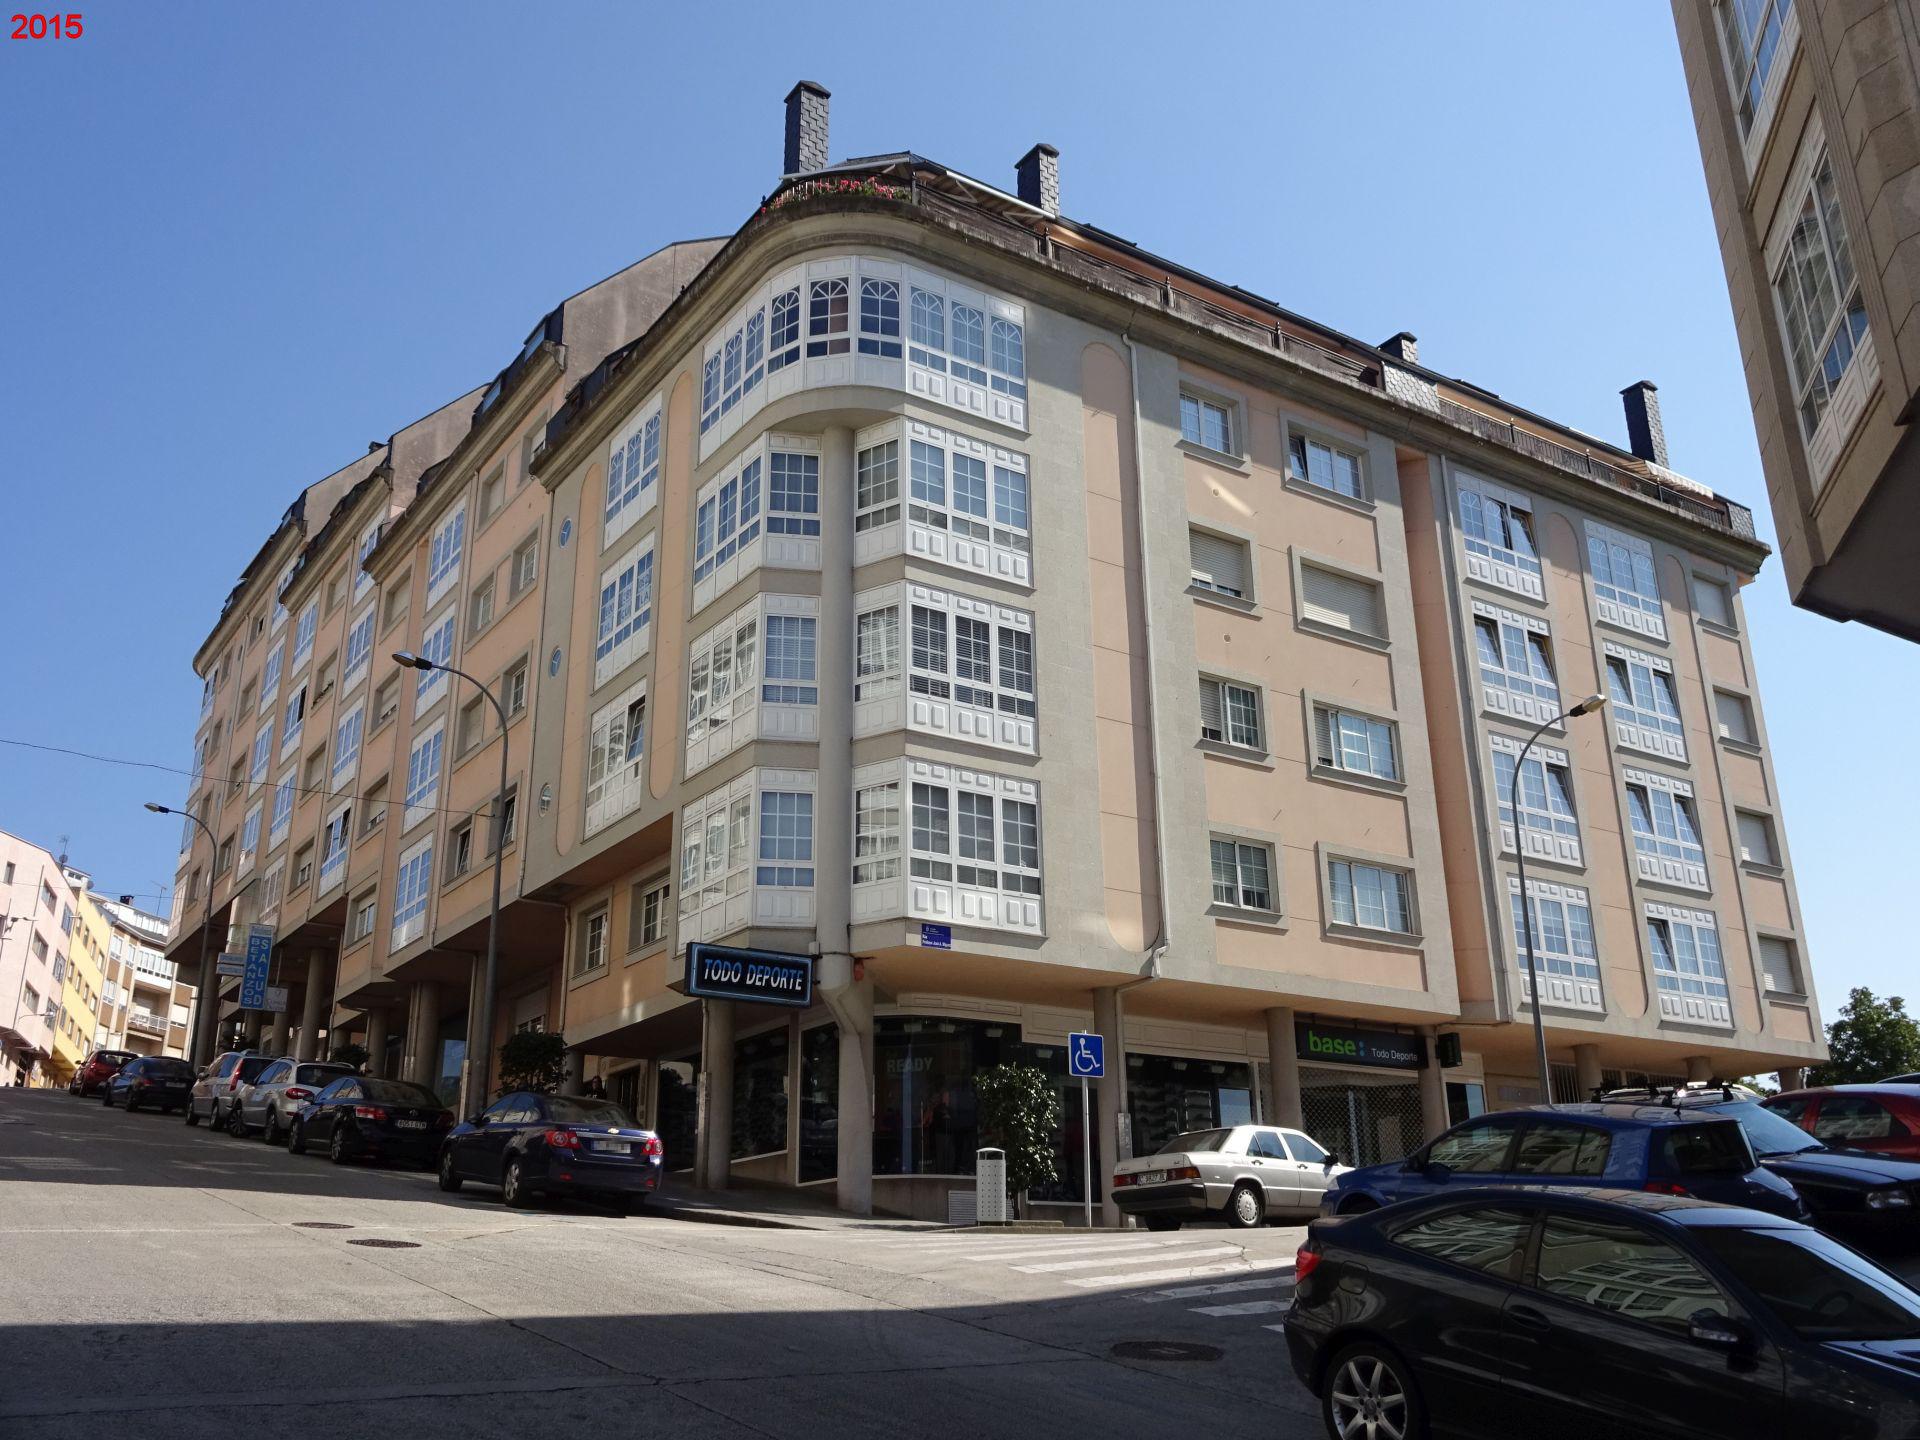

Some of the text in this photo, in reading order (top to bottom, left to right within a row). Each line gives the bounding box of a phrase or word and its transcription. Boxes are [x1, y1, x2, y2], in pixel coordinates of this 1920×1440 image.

[244, 937, 260, 1004] BETANZOS
[253, 939, 269, 1005] SALUD
[704, 958, 804, 991] TODO DEPORTE
[887, 1056, 934, 1073] READY
[1371, 1048, 1418, 1063] Todo Deporte
